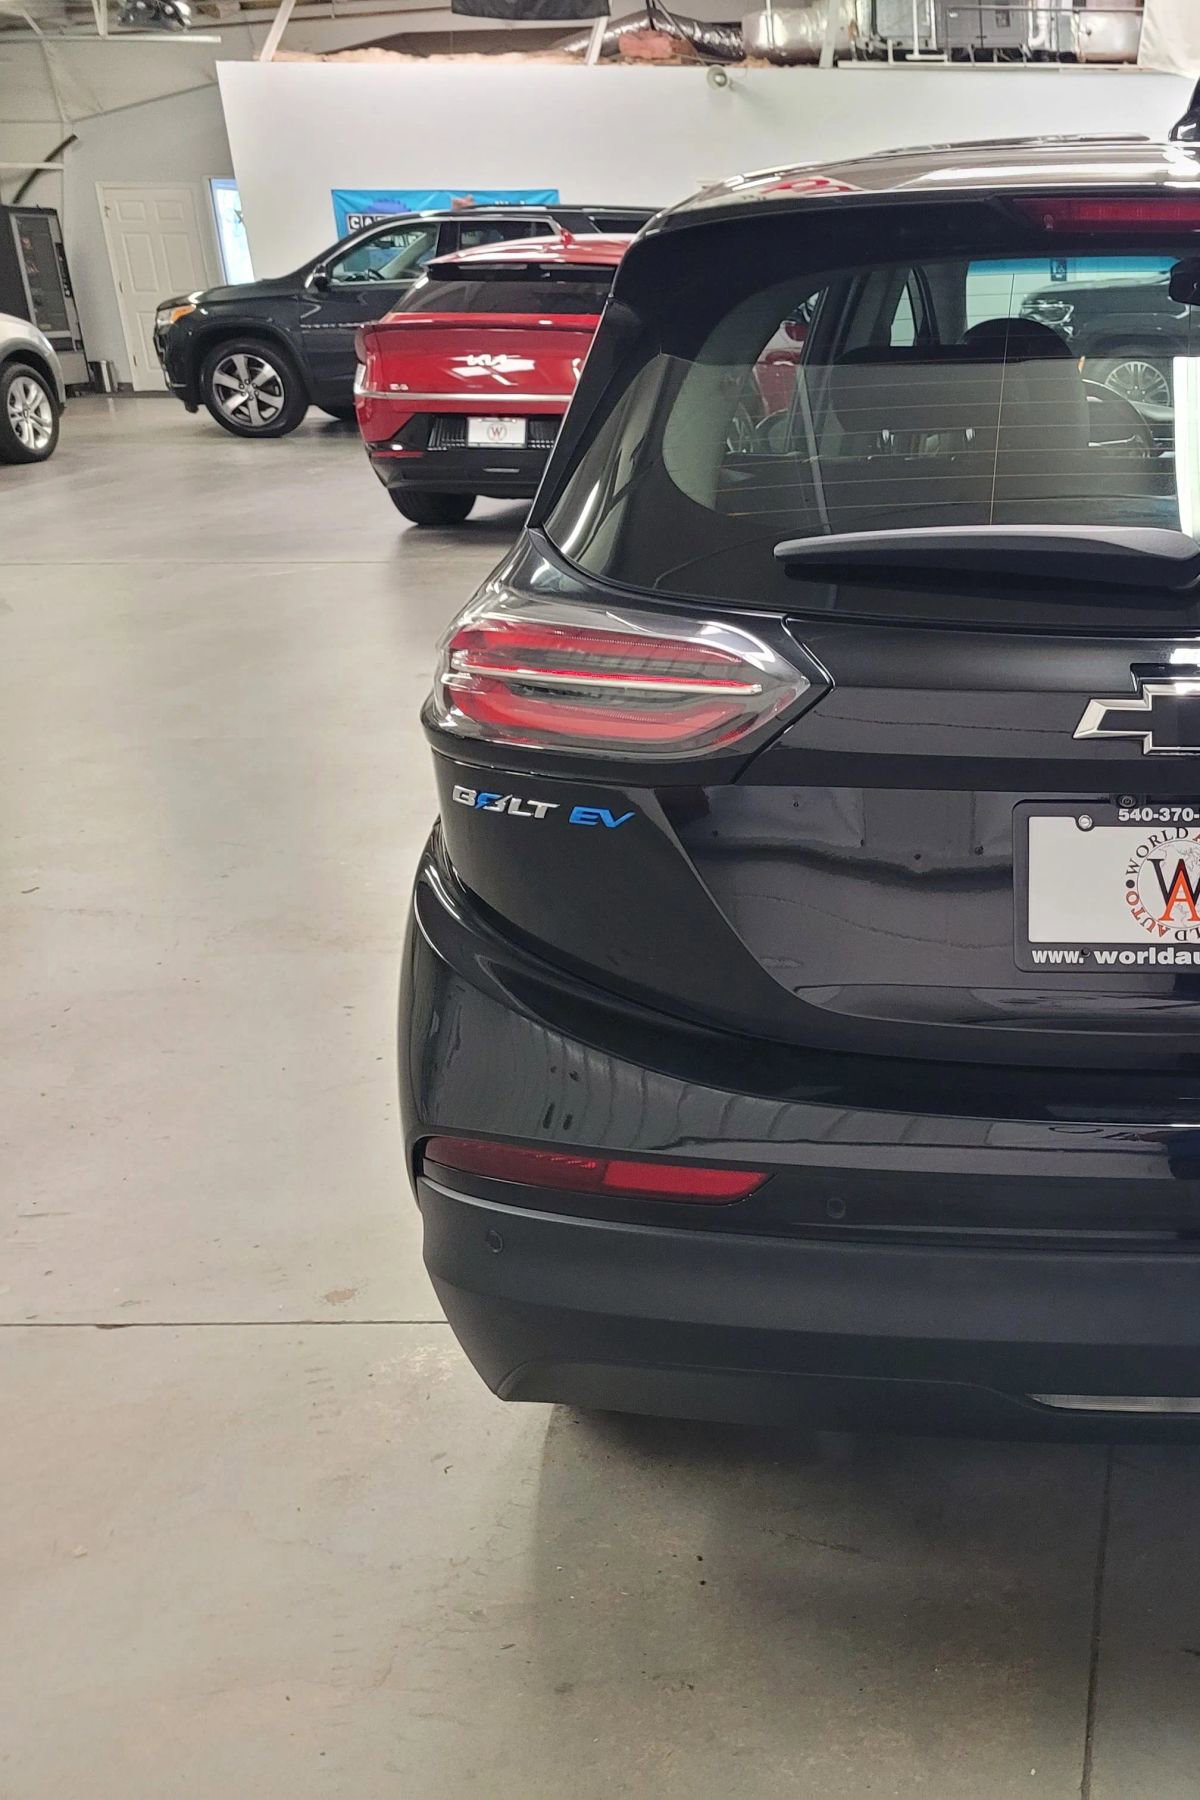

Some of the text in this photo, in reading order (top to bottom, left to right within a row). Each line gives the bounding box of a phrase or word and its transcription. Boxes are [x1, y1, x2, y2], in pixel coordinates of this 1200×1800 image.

[452, 784, 636, 829] BOLT EV
[1126, 826, 1189, 875] WORLD
[1125, 890, 1171, 938] AUTO
[1032, 949, 1084, 964] www.
